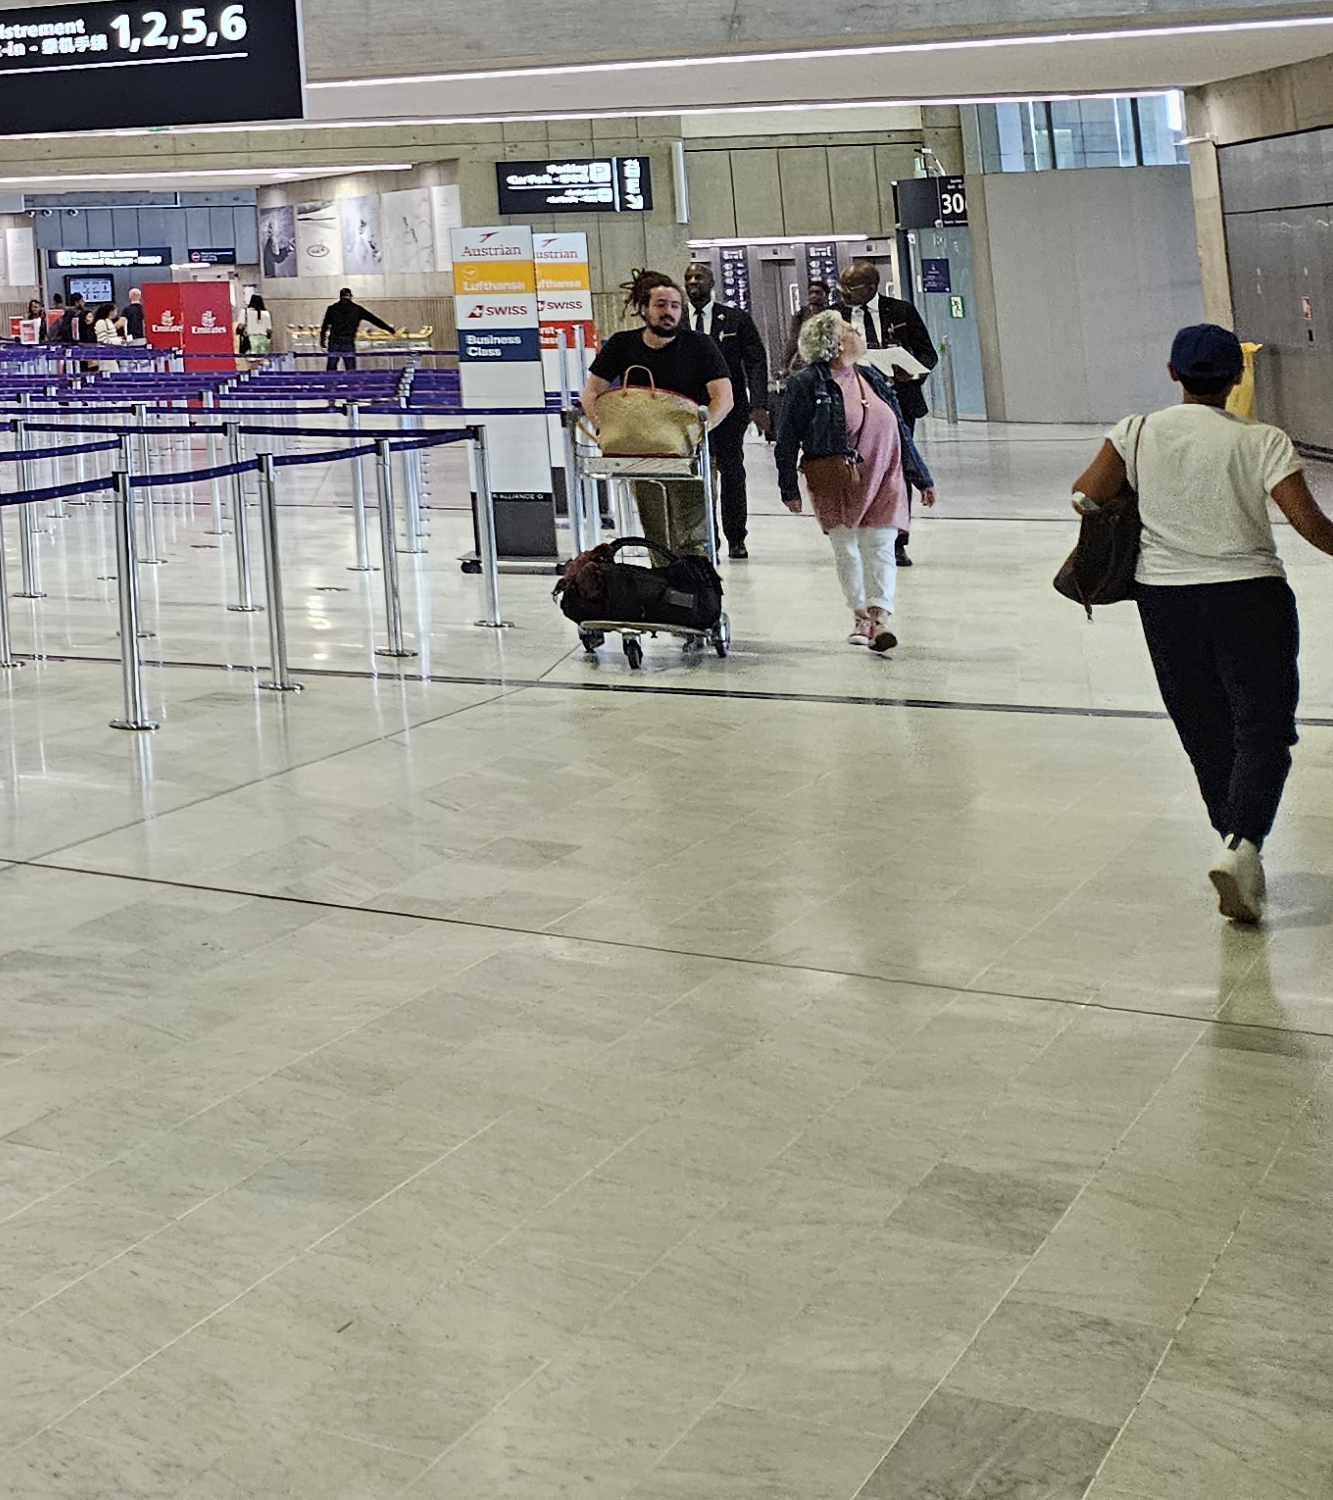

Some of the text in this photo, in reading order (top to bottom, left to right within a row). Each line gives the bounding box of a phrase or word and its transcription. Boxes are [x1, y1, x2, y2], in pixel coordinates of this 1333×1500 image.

[110, 4, 248, 53] 1,2,5,6
[941, 193, 968, 214] 30
[462, 246, 521, 257] Austrian
[535, 250, 578, 259] ustrian
[463, 280, 525, 291] Lufthansa
[485, 305, 528, 316] SWISS
[547, 301, 583, 310] SWISS
[191, 326, 227, 334] Emirates
[465, 334, 521, 345] Business
[466, 346, 502, 357] Class
